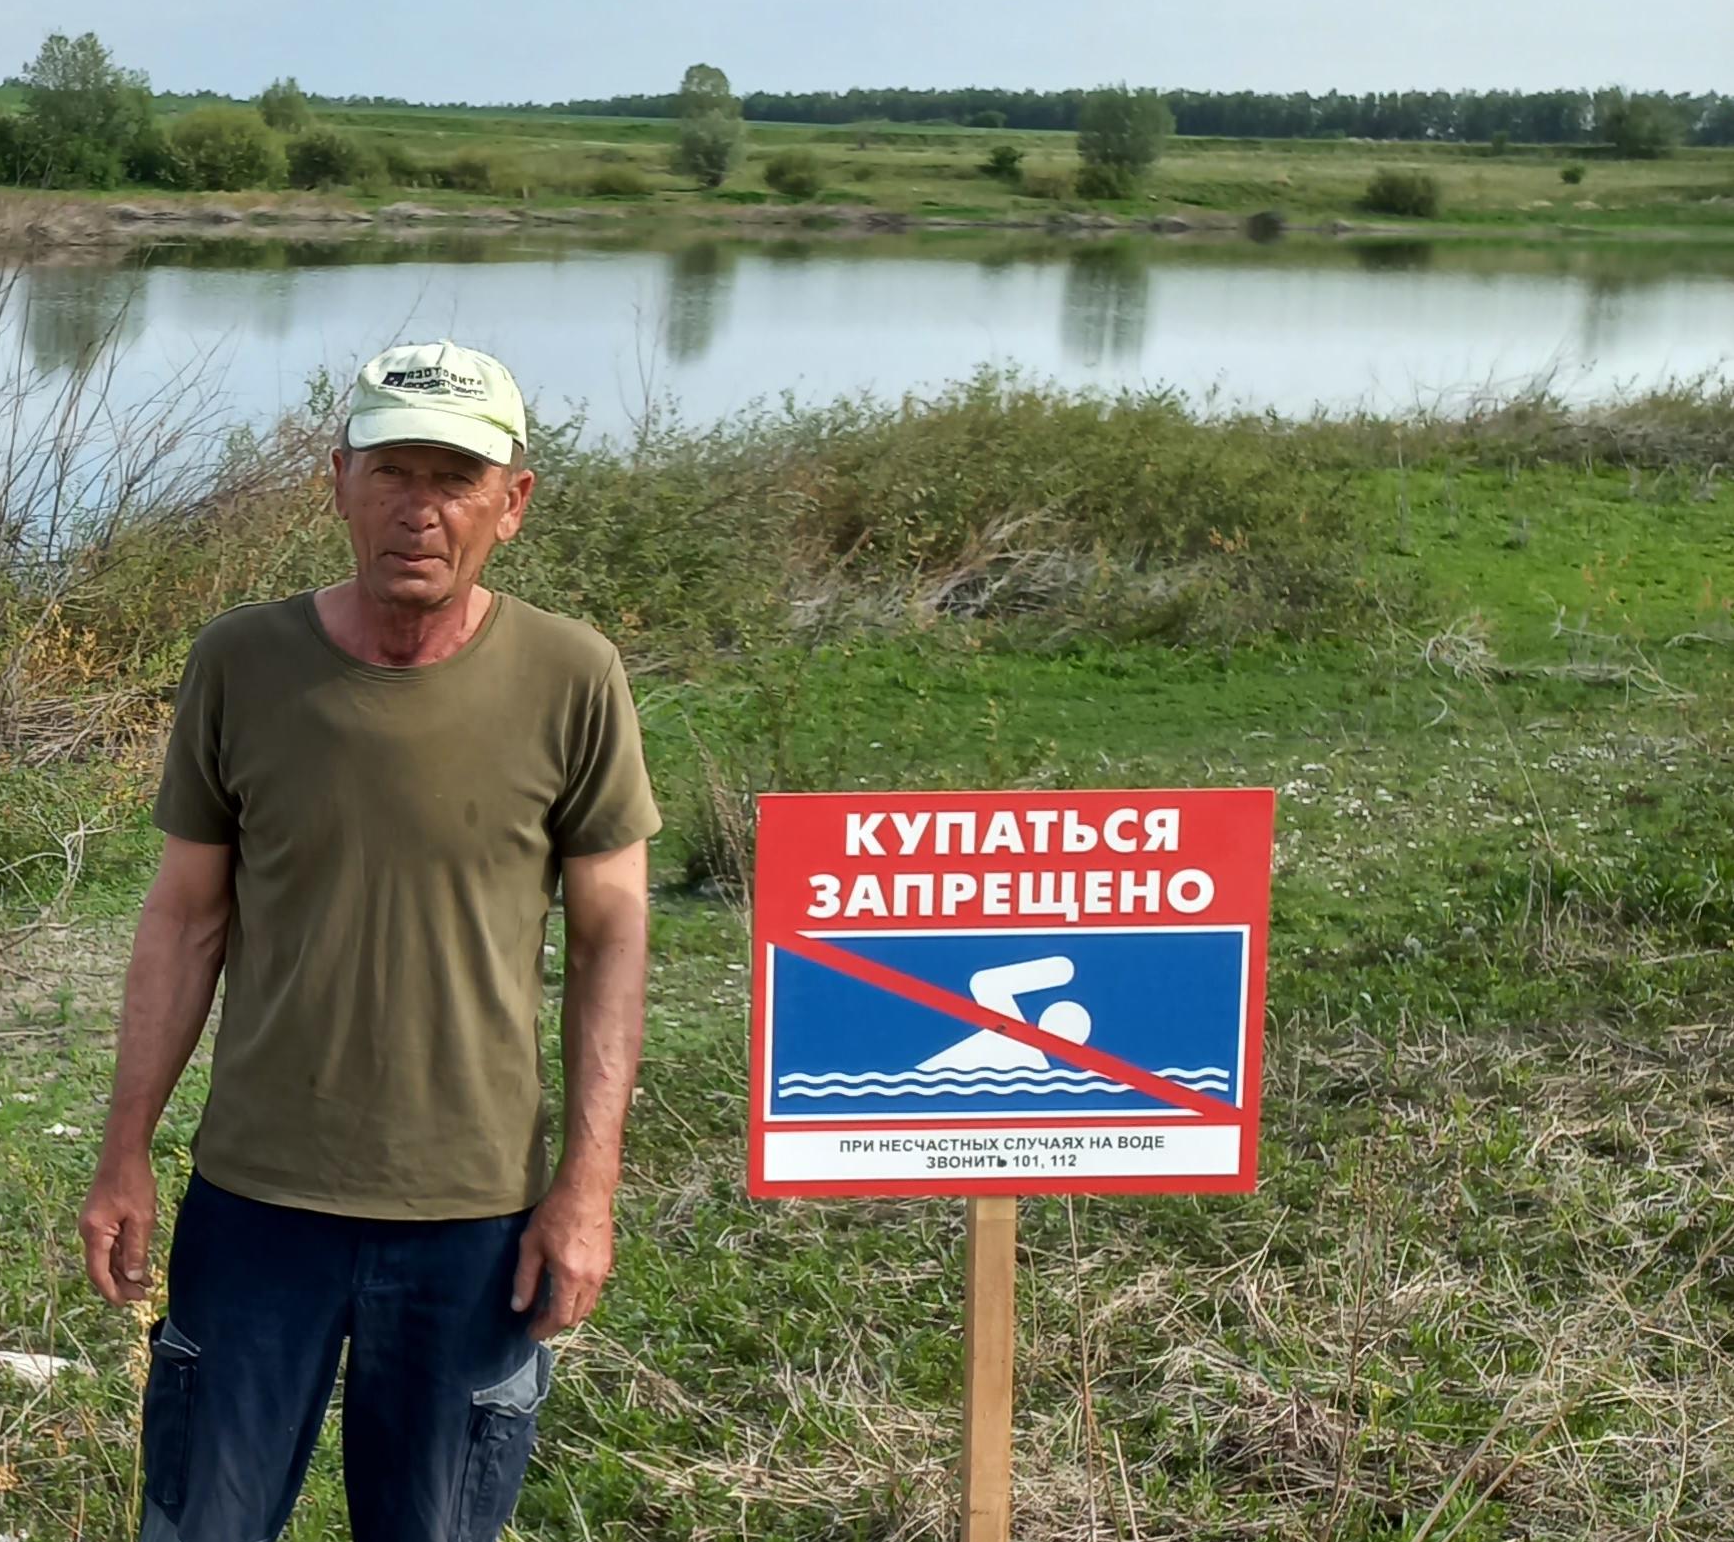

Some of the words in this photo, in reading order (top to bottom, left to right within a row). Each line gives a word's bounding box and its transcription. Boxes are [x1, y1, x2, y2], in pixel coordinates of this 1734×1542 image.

[845, 808, 1180, 856] КУПАТЬСЯ
[806, 868, 1215, 922] ЗАПРЕЩЕНО
[840, 1140, 874, 1152] ПРИ
[879, 1138, 999, 1152] НЕСЧАСТНЫХ
[1004, 1137, 1084, 1151] СЛУЧАЯХ
[1089, 1137, 1113, 1149] НА
[1118, 1136, 1165, 1150] ВОДЕ
[926, 1155, 1007, 1169] ЗВОНИТЬ
[1012, 1155, 1045, 1168] 101,
[1050, 1154, 1077, 1167] 112
